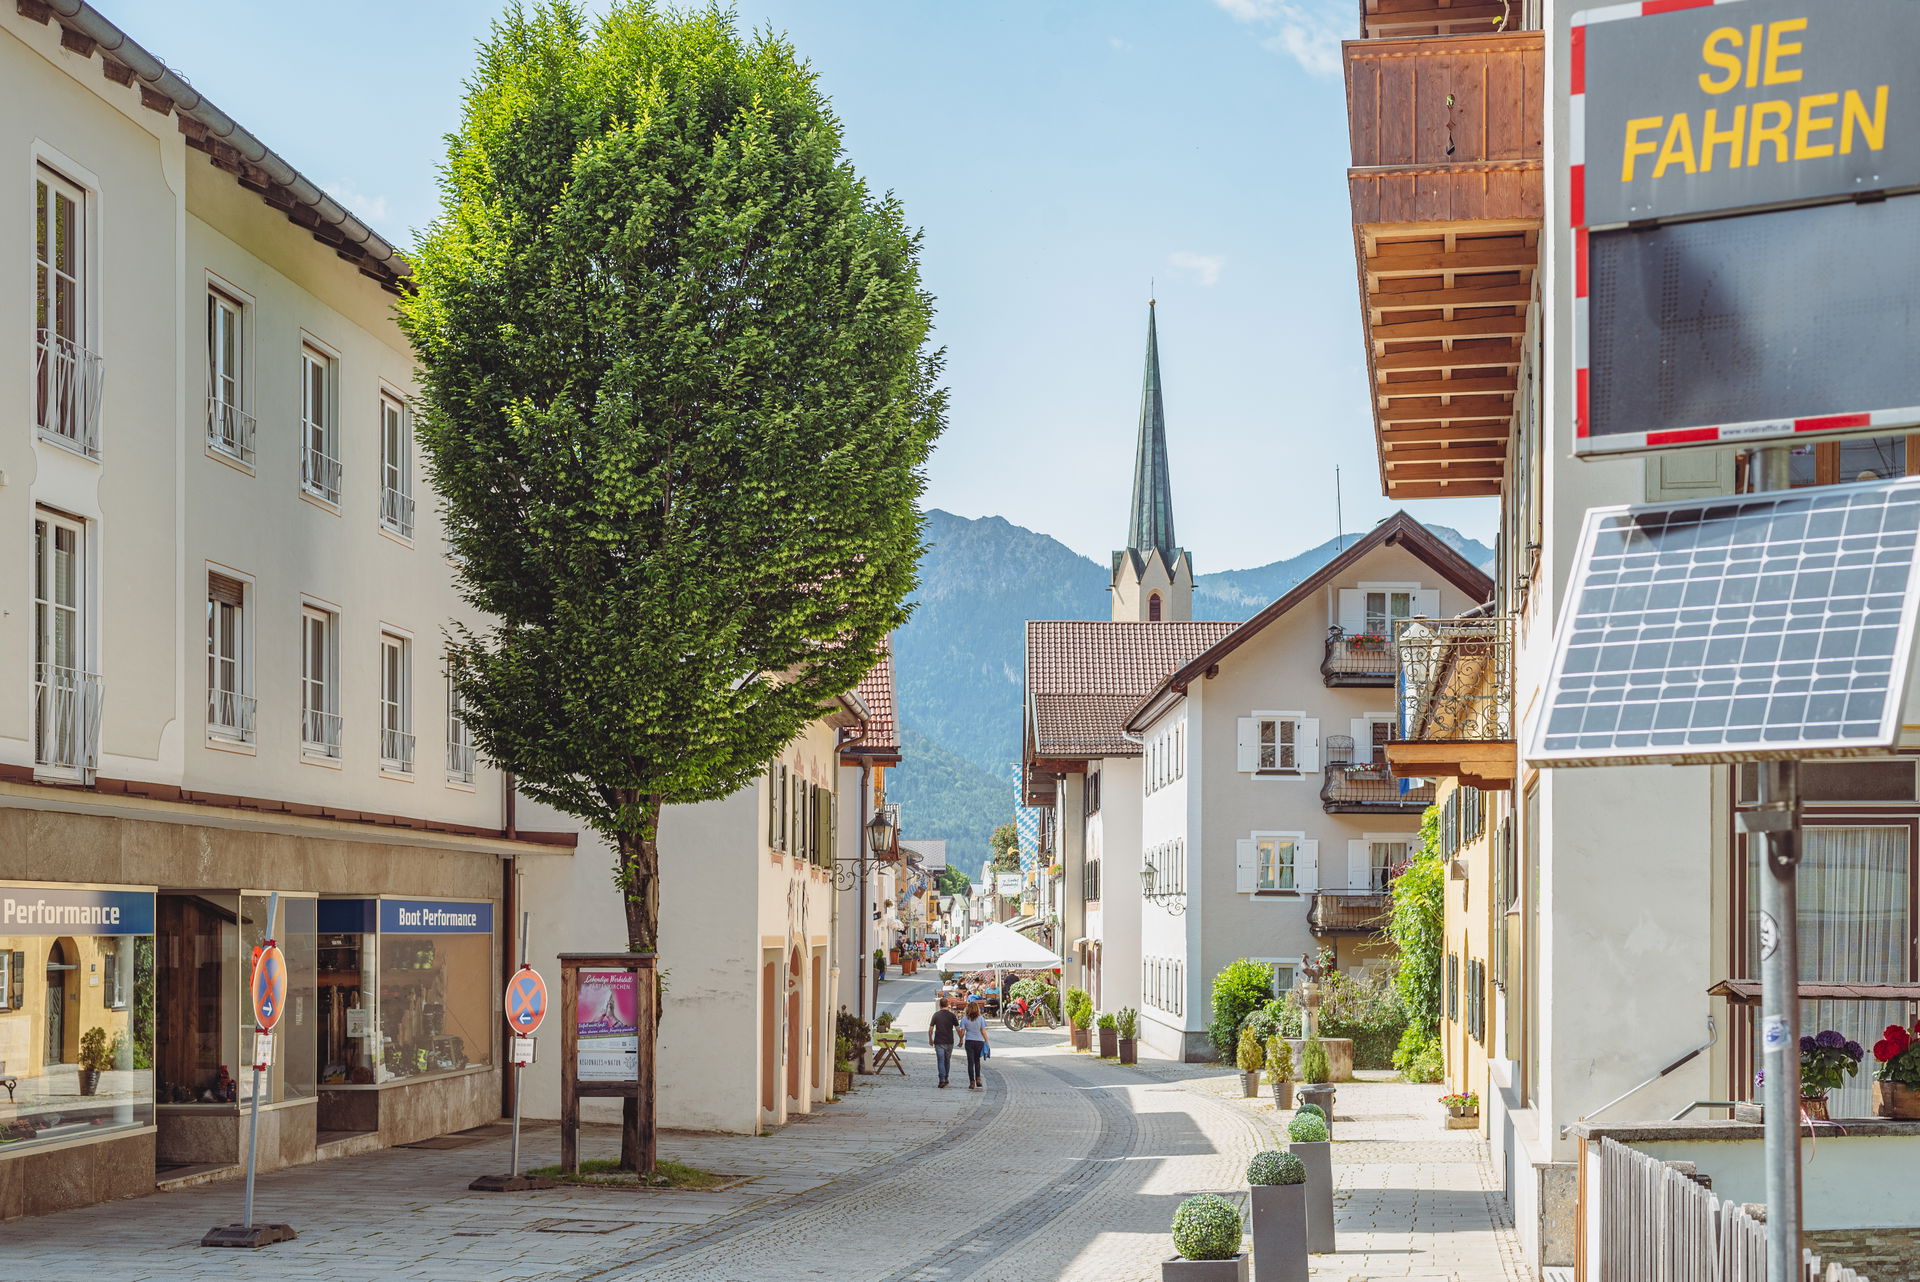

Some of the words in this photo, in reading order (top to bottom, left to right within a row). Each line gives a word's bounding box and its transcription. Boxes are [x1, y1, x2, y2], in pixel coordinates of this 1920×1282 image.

[1698, 17, 1808, 95] SIE
[1621, 85, 1889, 182] FAHREN
[3, 898, 120, 925] Performance
[399, 907, 421, 926] Boot
[422, 908, 477, 927] Performance
